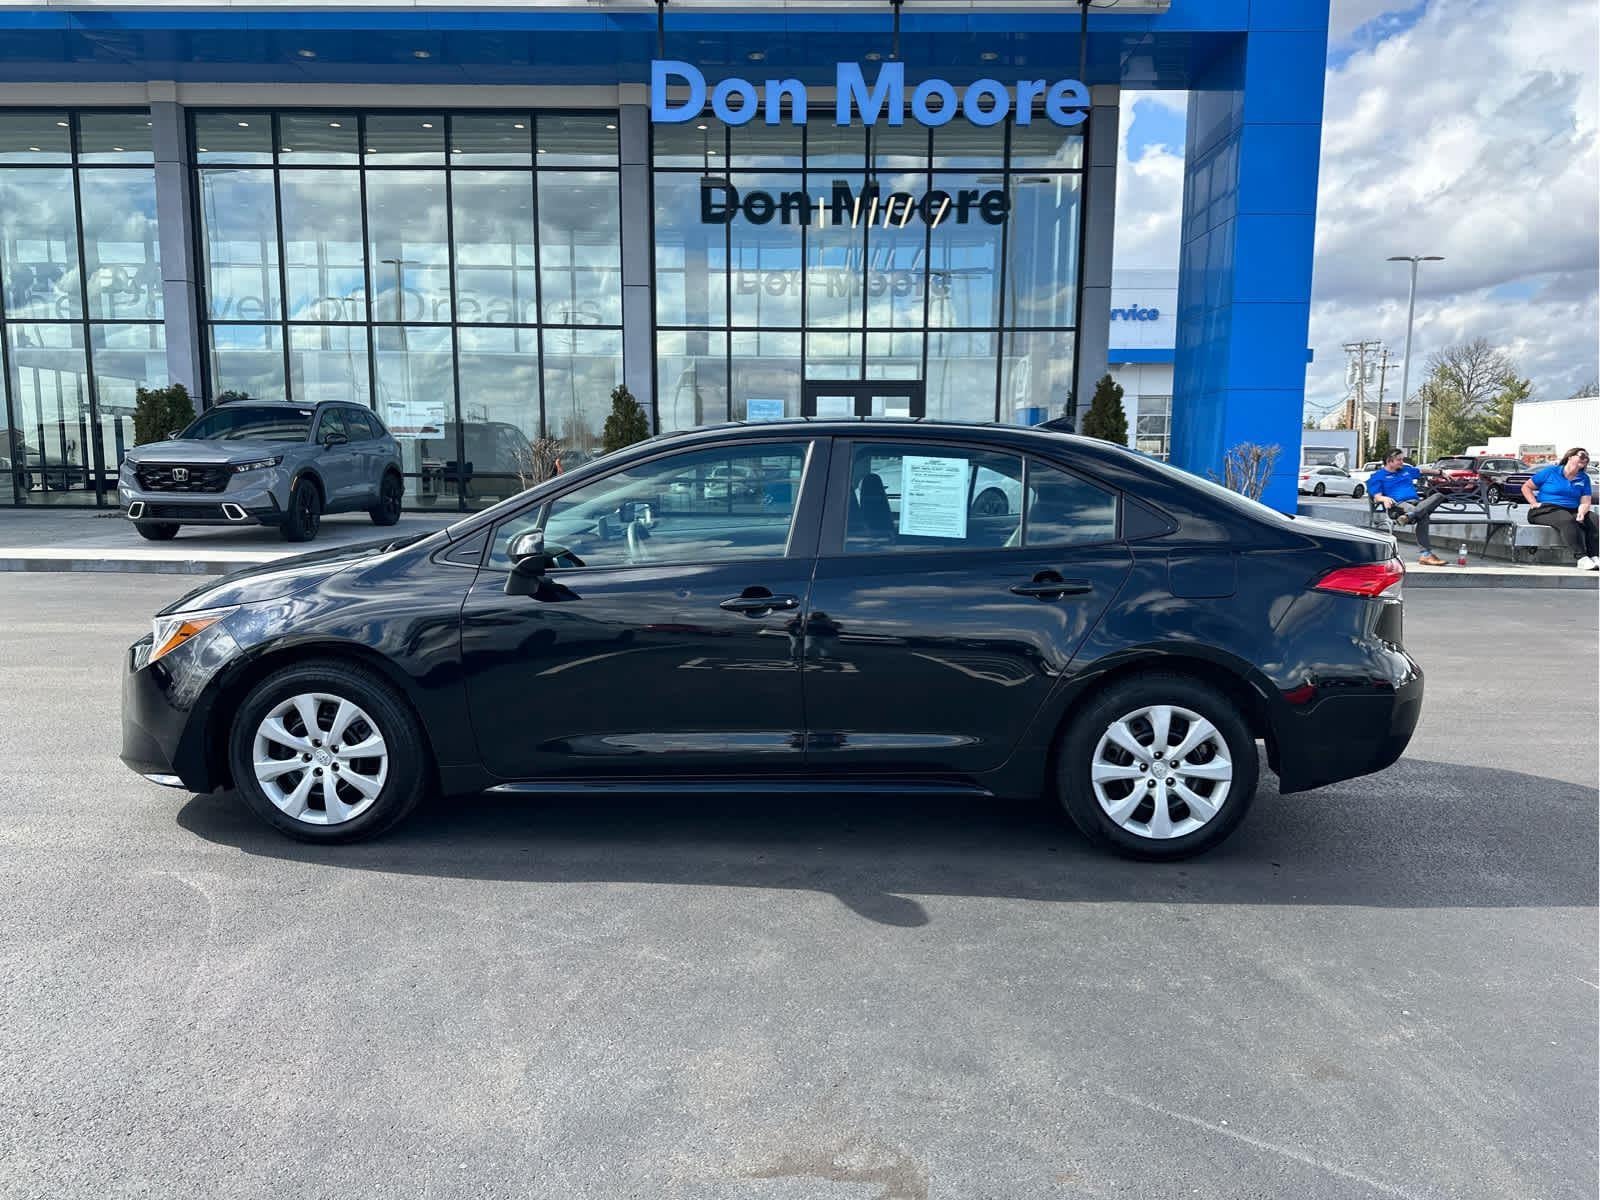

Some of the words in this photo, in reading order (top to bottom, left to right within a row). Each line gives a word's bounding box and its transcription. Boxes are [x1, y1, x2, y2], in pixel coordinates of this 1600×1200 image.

[651, 59, 807, 126] Don
[836, 61, 1092, 127] Moore
[700, 177, 812, 225] Don
[832, 180, 1010, 225] Moore
[1111, 303, 1160, 321] rvice
